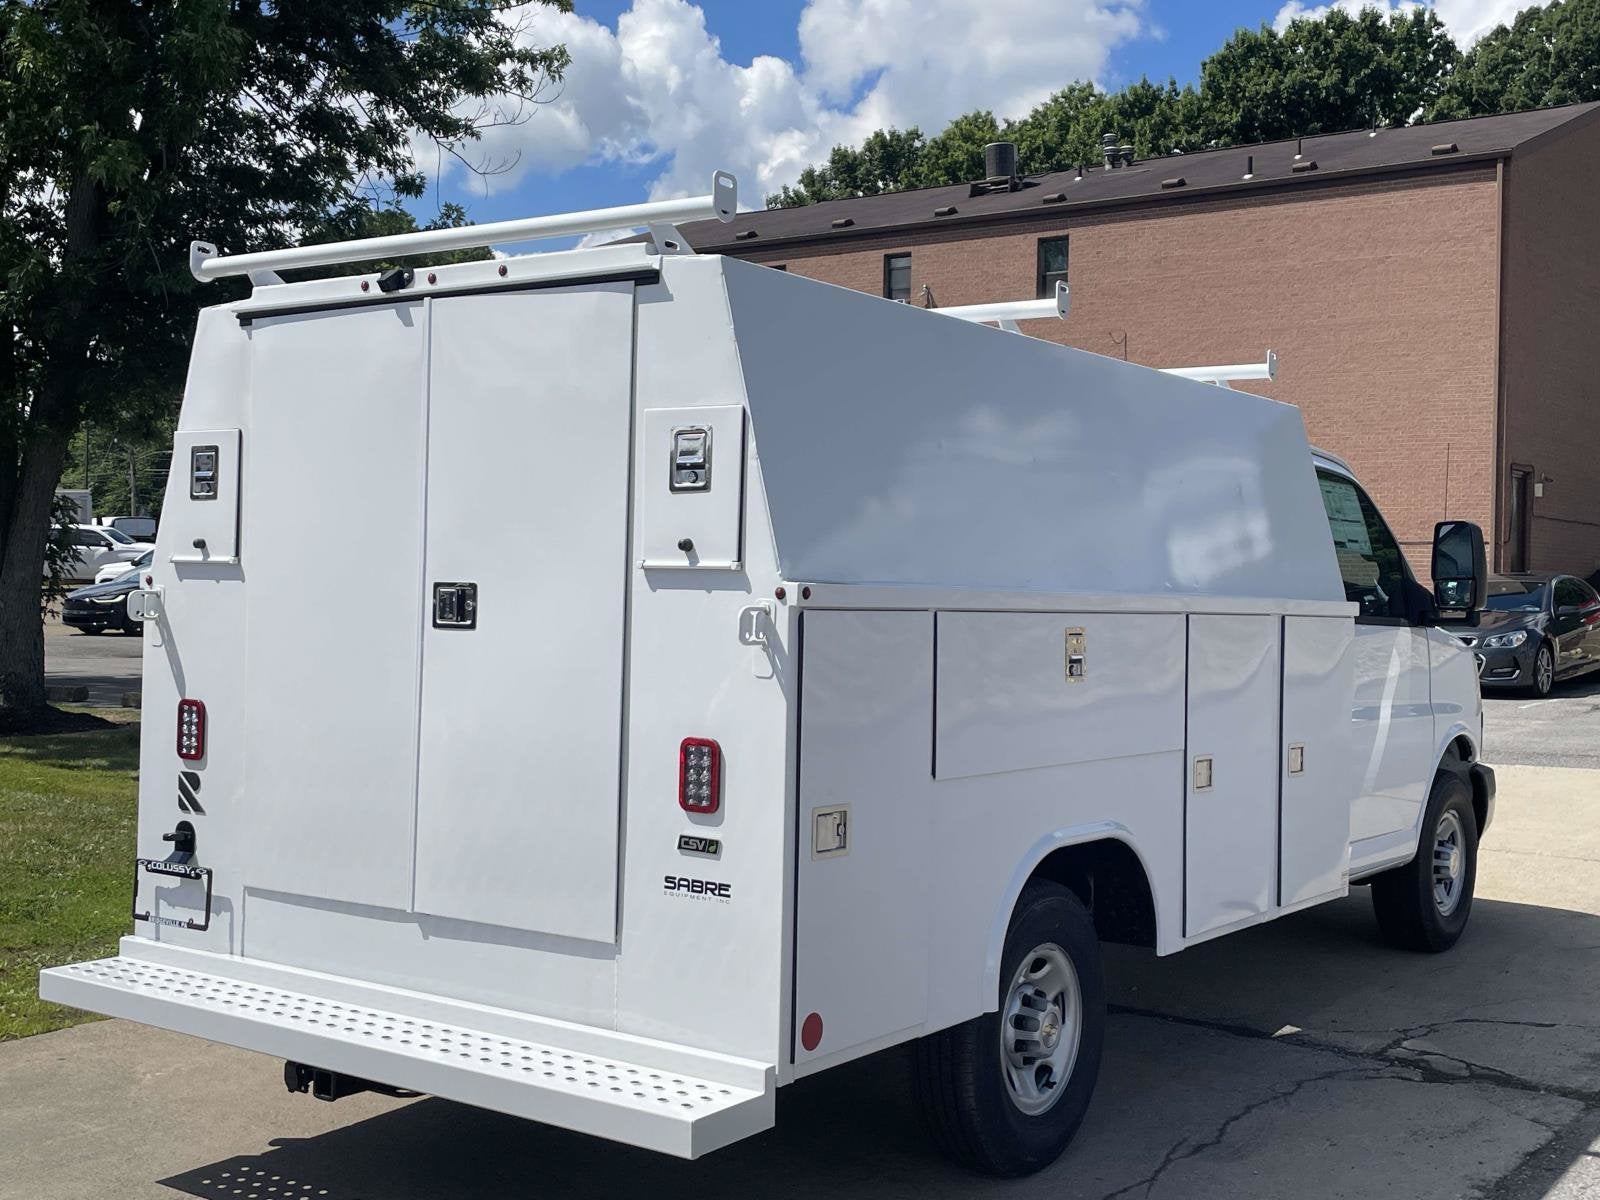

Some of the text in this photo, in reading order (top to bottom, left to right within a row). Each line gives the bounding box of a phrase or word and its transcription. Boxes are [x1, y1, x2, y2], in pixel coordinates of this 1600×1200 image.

[680, 836, 706, 851] CSV
[151, 861, 192, 875] COLUSSY
[663, 875, 732, 898] SABRE
[663, 890, 713, 902] EQUIPMENT
